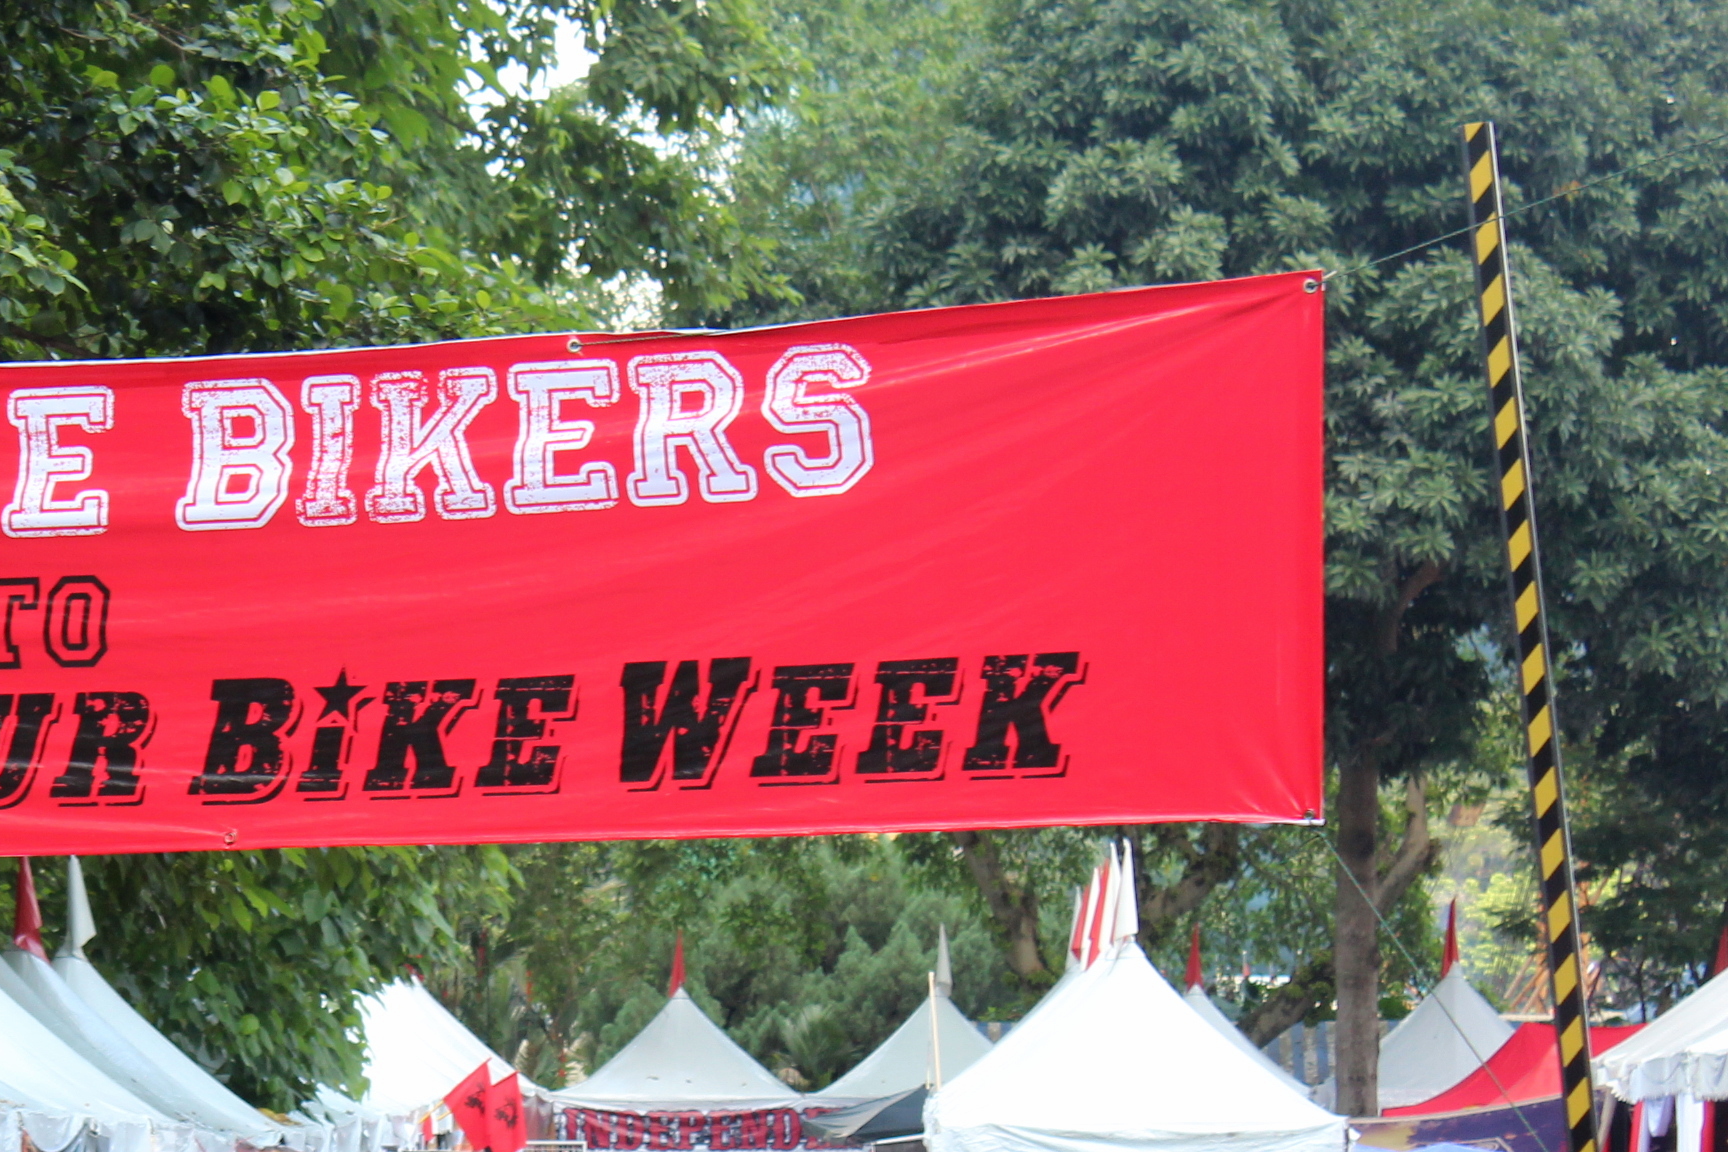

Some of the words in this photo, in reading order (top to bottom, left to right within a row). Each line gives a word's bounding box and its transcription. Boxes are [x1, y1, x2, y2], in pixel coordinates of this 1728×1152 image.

[175, 343, 874, 532] BIKERS
[619, 650, 1088, 792] WEEK
[556, 1107, 870, 1151] INDEPEND
